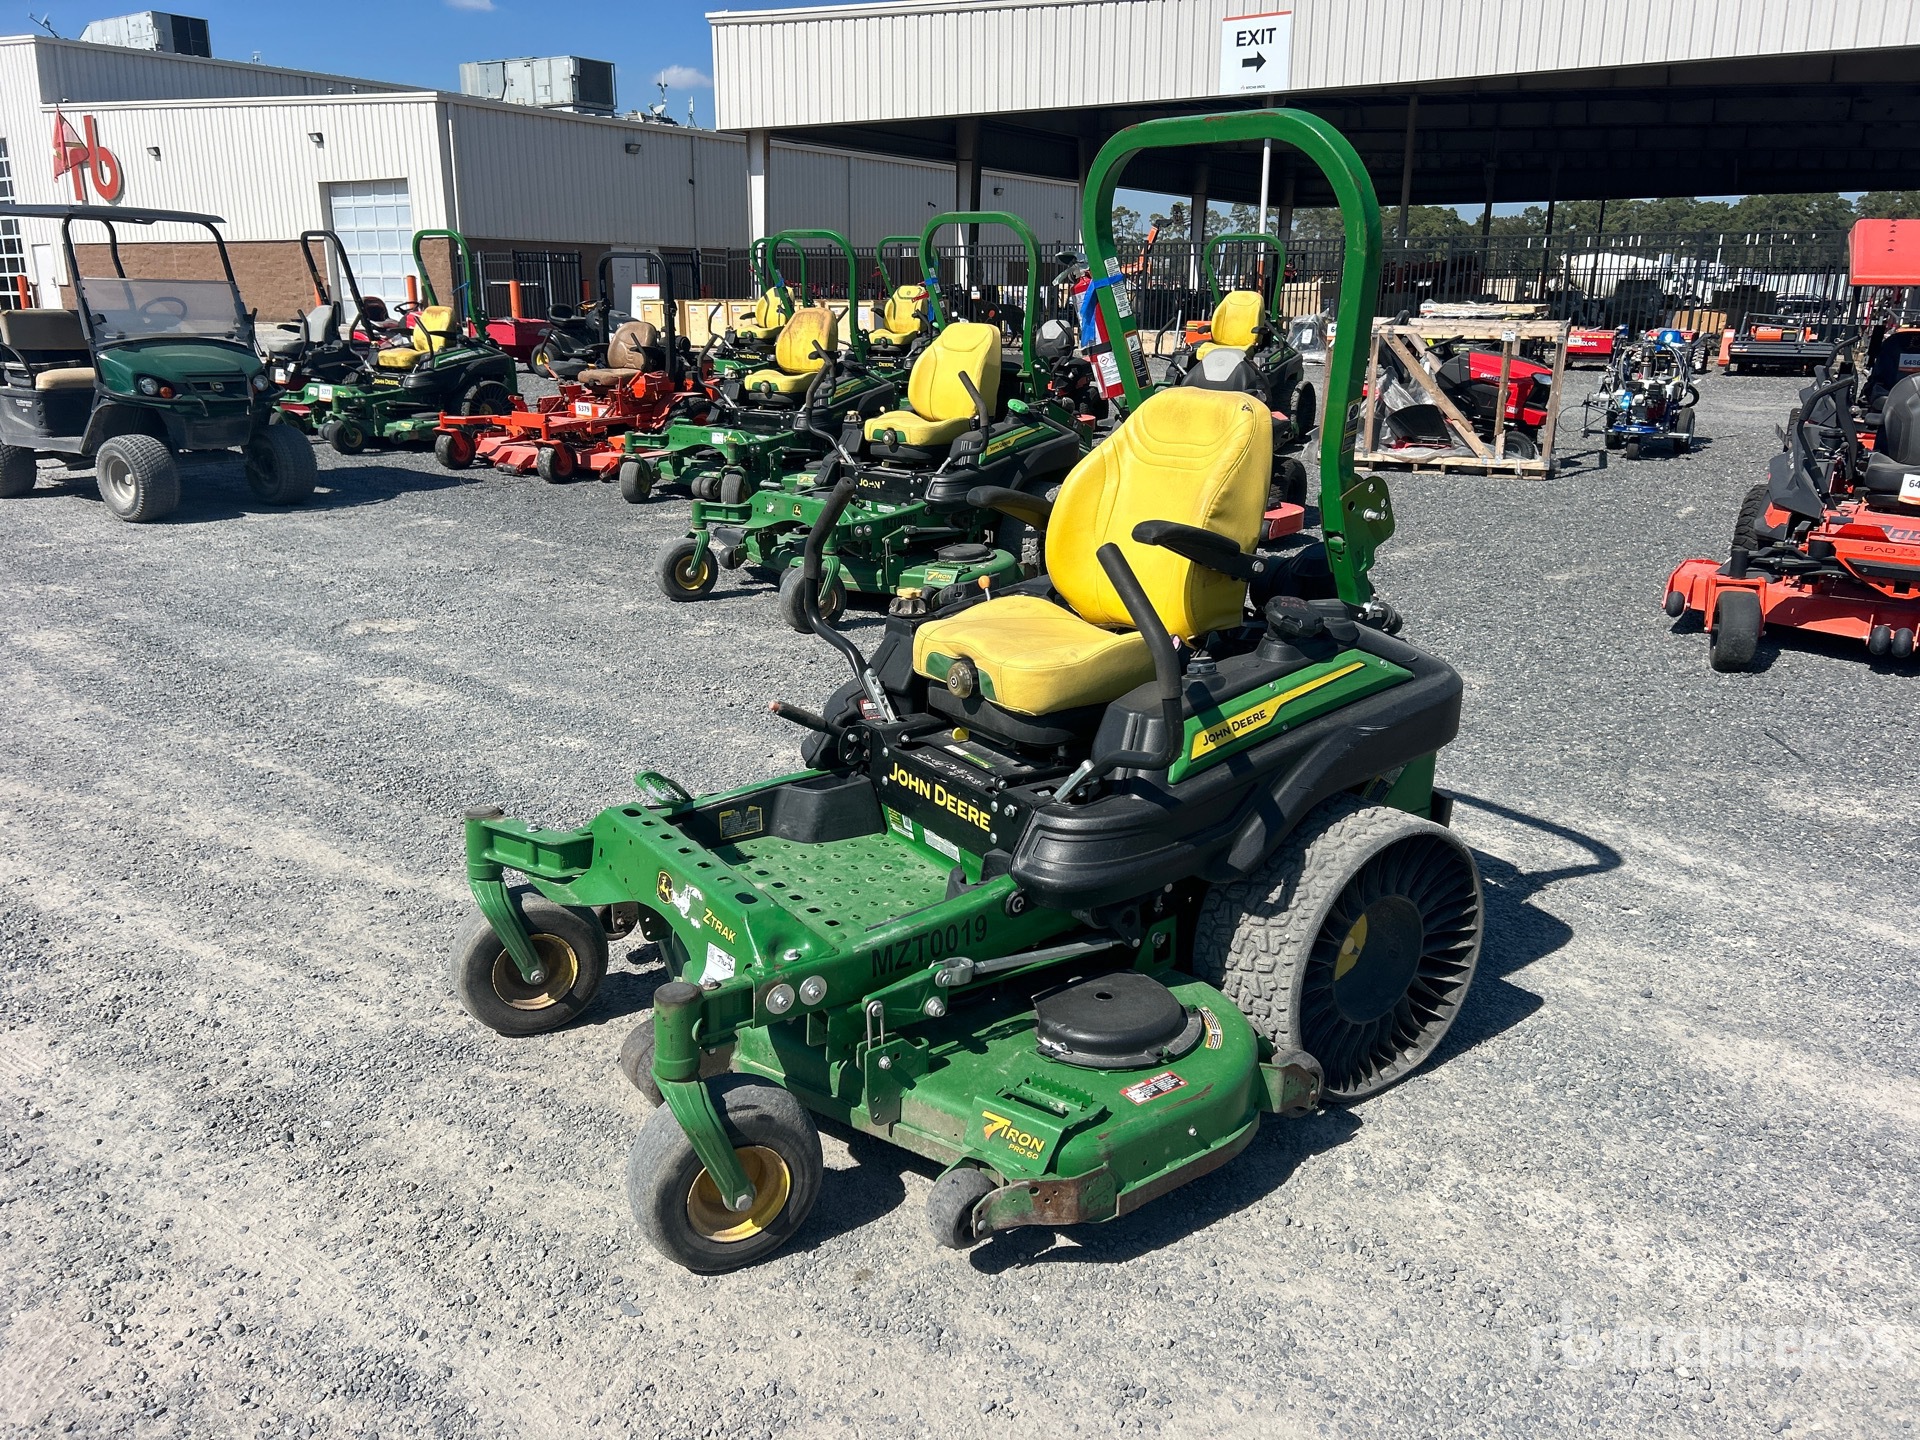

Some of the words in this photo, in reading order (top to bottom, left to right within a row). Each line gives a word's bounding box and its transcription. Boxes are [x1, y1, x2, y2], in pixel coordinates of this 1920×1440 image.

[1236, 27, 1277, 47] EXIT
[1864, 545, 1896, 554] BAD
[1203, 725, 1231, 747] JOHN
[1231, 709, 1267, 733] DEERE
[889, 762, 931, 800] JOHN
[934, 783, 991, 833] DEERE
[703, 907, 737, 945] ZTRAK
[871, 914, 988, 978] MZT0019
[1008, 1143, 1026, 1155] PRO
[1026, 1151, 1039, 1160] 60
